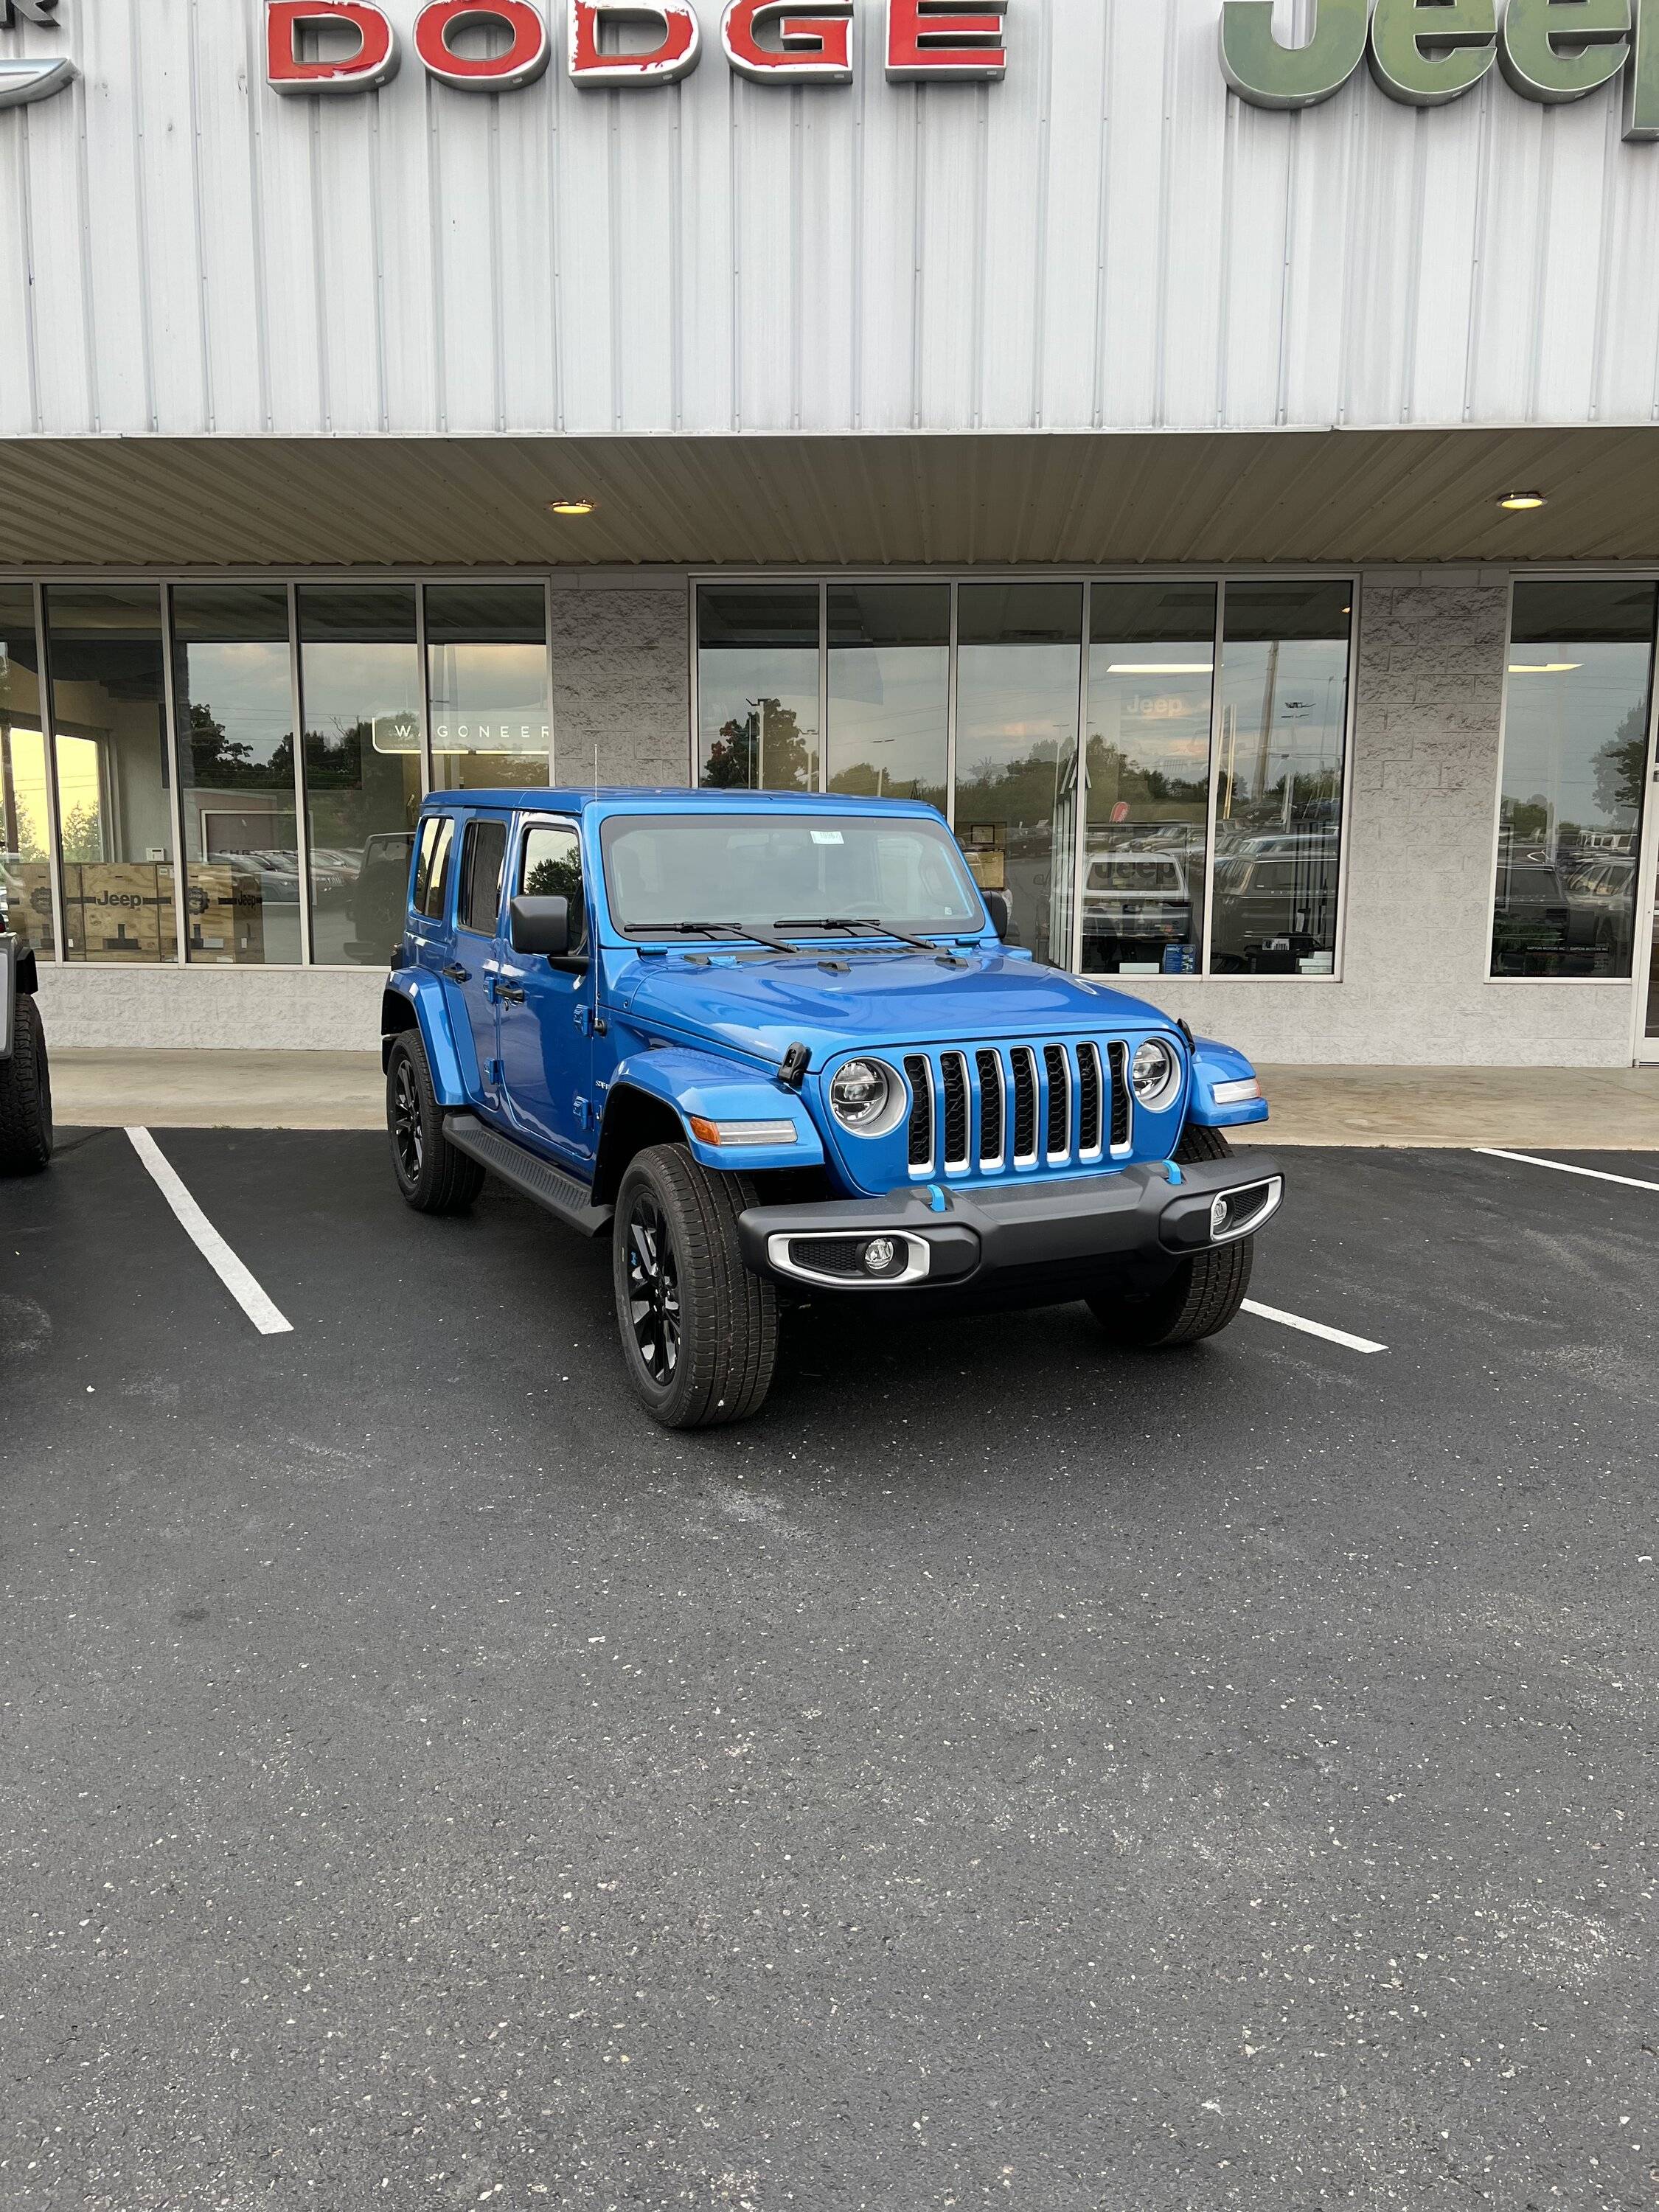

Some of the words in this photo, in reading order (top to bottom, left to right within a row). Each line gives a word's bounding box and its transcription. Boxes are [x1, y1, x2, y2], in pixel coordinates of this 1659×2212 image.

[266, 0, 1007, 92] DODGE
[1219, 0, 1659, 141] Jee
[1126, 694, 1183, 718] Jeep
[394, 725, 549, 737] WGONEER
[1095, 857, 1178, 884] Jeep
[97, 891, 142, 909] Jeep
[237, 891, 255, 908] Jeep
